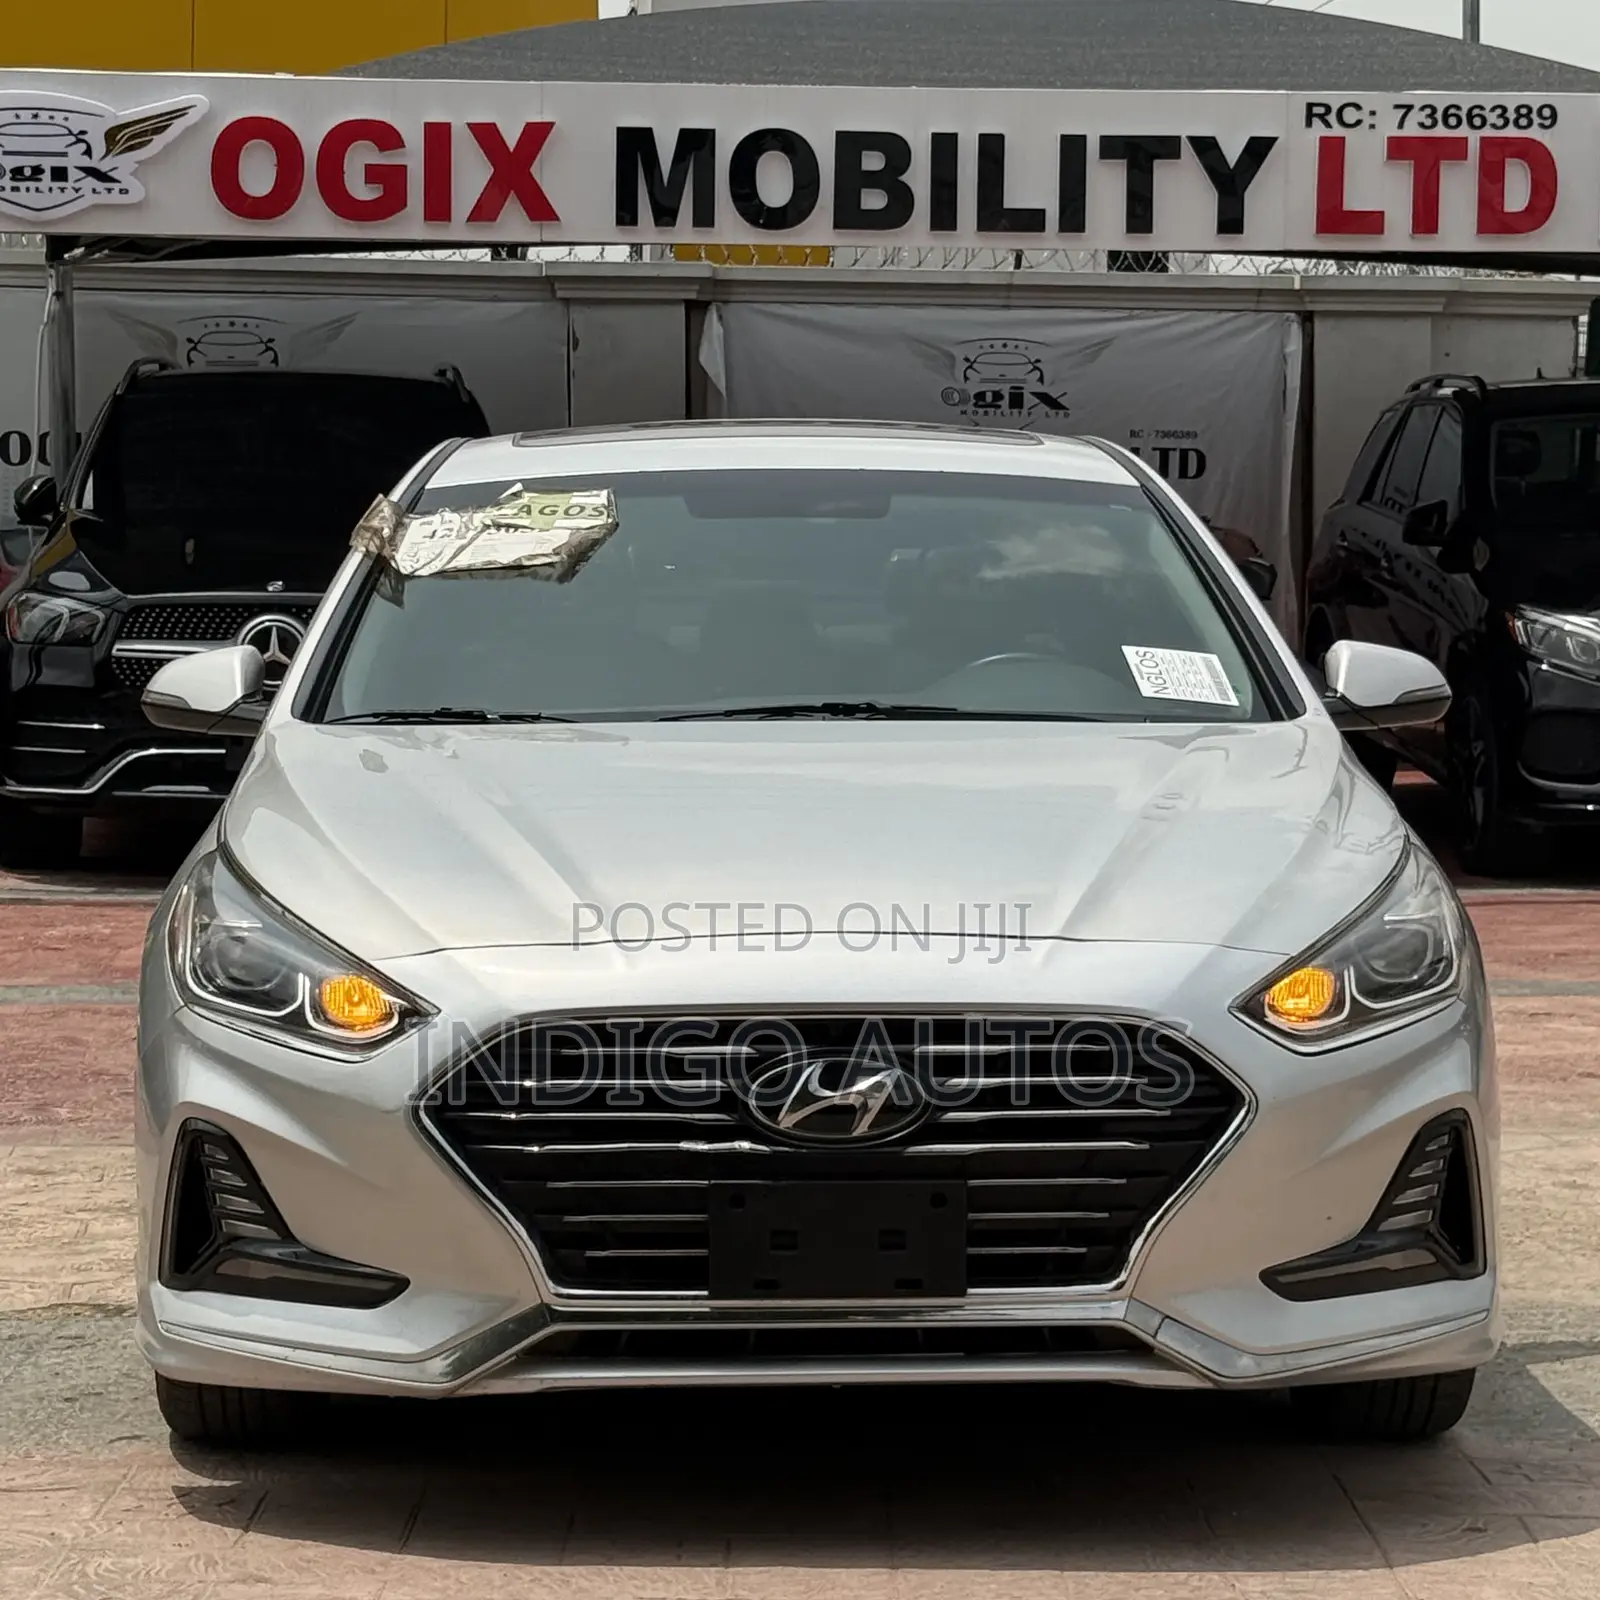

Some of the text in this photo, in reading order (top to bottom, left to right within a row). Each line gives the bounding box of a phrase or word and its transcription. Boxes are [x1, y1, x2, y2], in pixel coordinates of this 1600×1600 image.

[1306, 103, 1558, 130] RC: 7366389
[211, 117, 1558, 235] OGIX MOBILITY LTD
[92, 187, 130, 195] LTD
[960, 410, 1033, 419] MOBILITY
[1130, 429, 1144, 439] RC
[1130, 446, 1206, 479] TD
[1135, 650, 1171, 695] NGLOS
